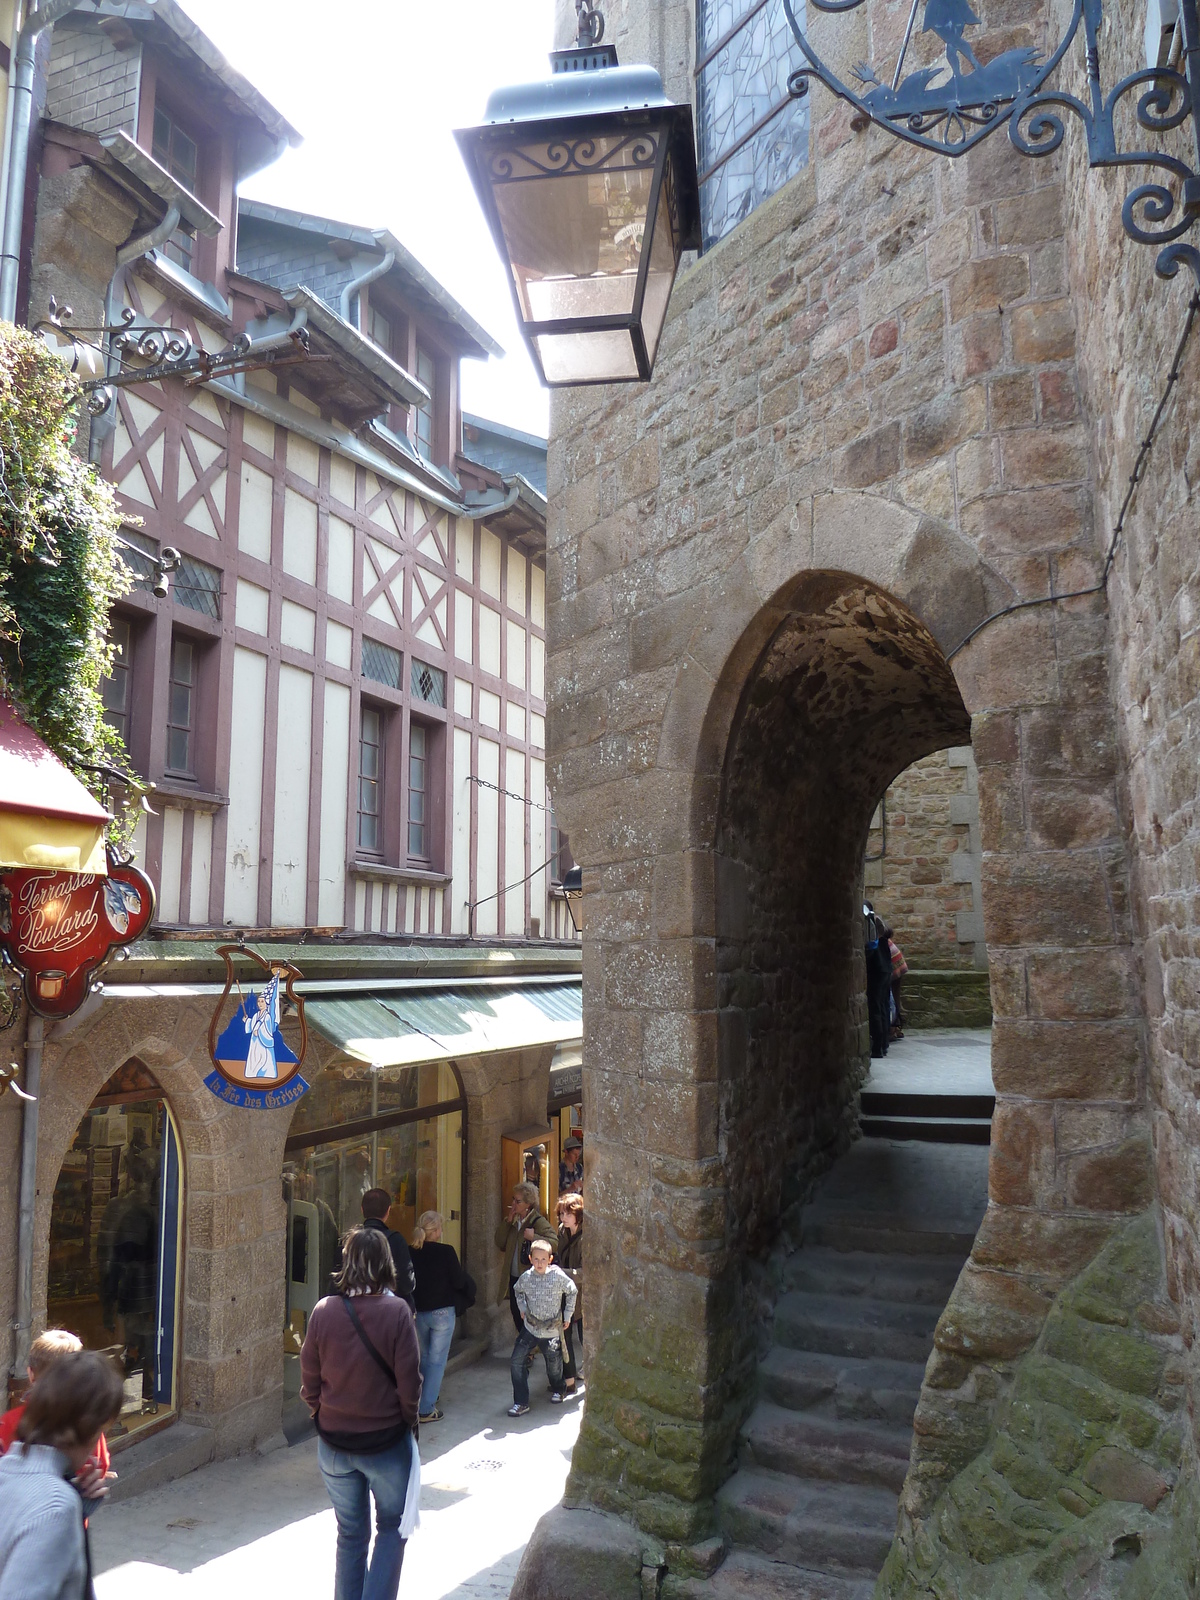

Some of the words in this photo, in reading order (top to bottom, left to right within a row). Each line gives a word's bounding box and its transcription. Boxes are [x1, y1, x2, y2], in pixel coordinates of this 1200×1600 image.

[18, 890, 99, 953] Poulard
[244, 1092, 261, 1108] des
[265, 1082, 304, 1108] Grèves
